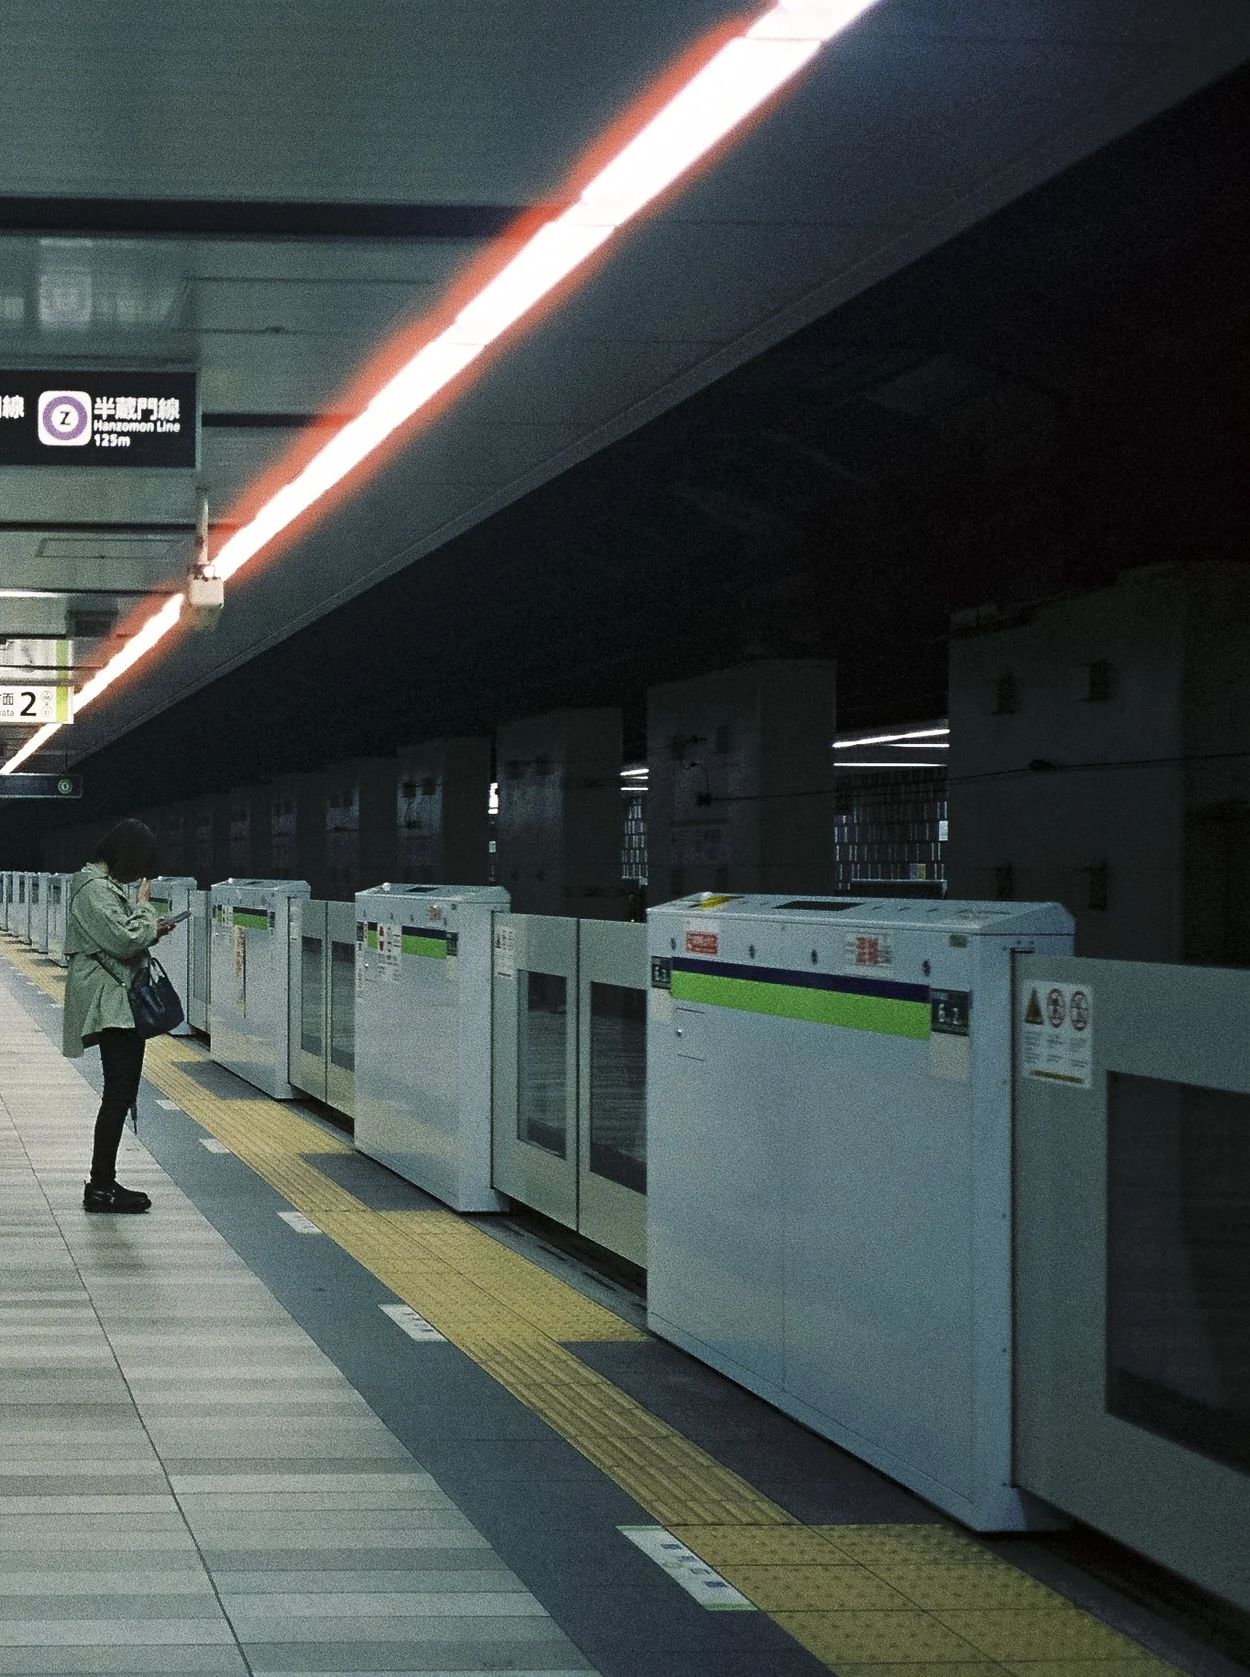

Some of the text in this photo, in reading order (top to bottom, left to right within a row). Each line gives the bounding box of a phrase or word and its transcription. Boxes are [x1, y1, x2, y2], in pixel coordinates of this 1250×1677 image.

[94, 397, 180, 421] 半蔵門線
[59, 411, 70, 426] Z
[94, 420, 180, 433] Hanzomon Line
[94, 434, 131, 447] 125m
[19, 691, 37, 717] 2
